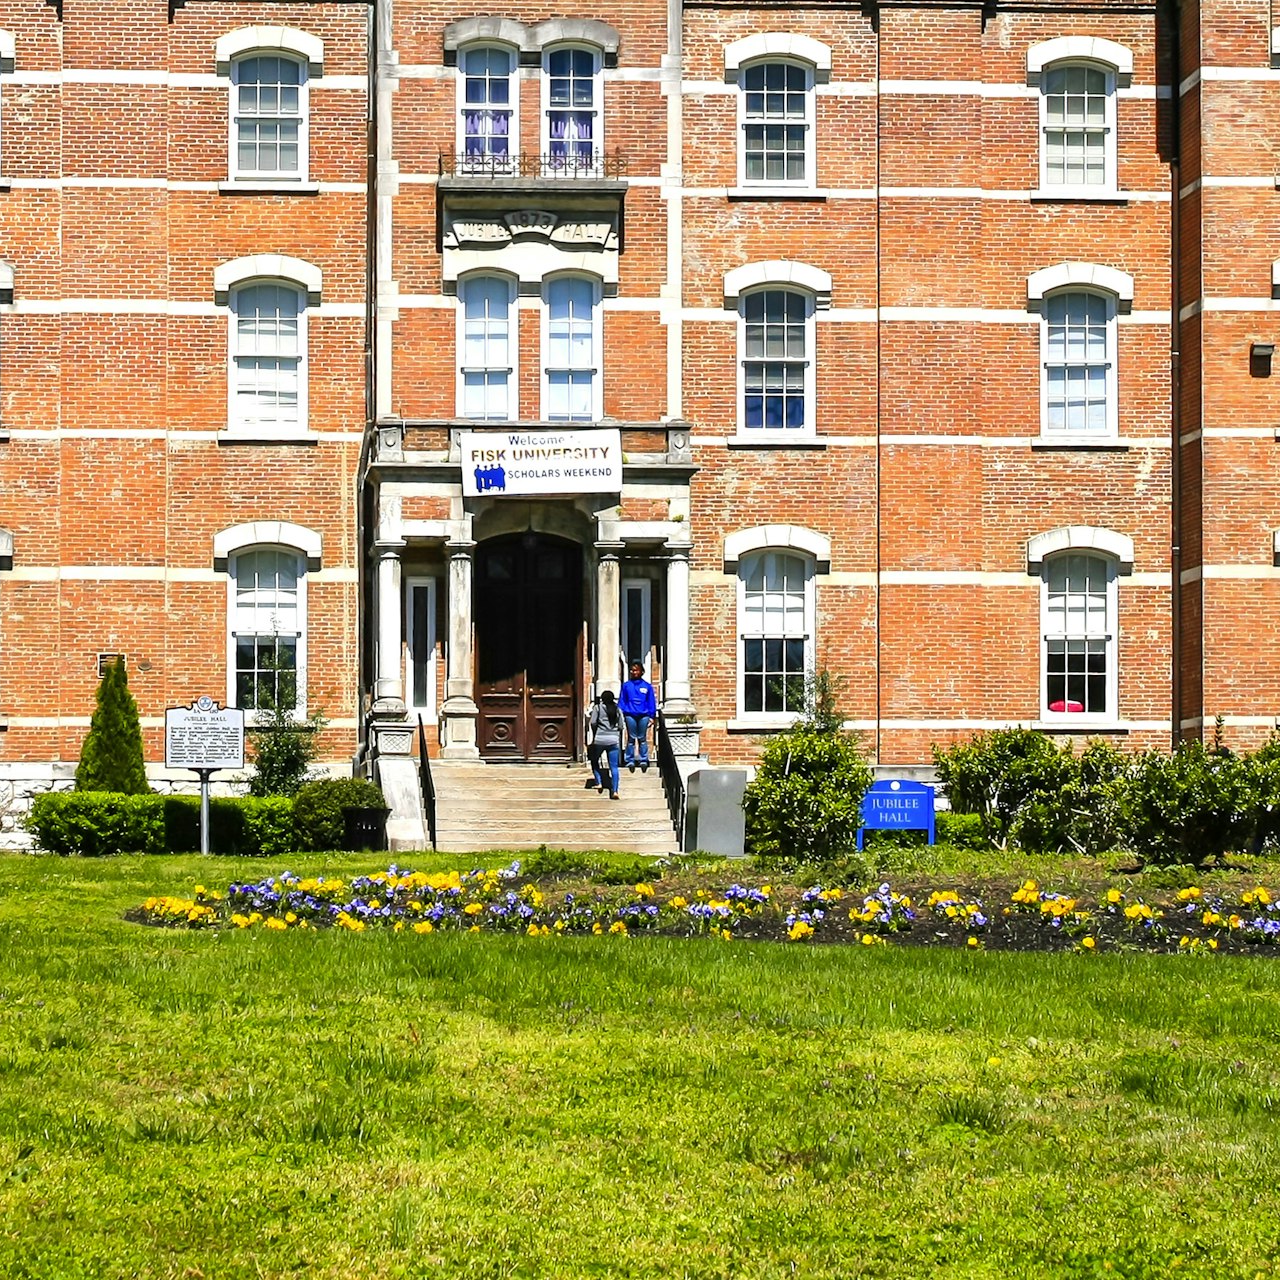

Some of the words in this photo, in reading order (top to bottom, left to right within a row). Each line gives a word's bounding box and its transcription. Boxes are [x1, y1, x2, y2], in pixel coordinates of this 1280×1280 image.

[511, 213, 551, 229] 1873
[562, 222, 604, 239] HALL
[508, 435, 565, 446] Welcome
[471, 449, 507, 462] FISK
[512, 446, 610, 461] UNIVERSITY
[508, 469, 560, 479] SCHOLARS
[564, 467, 612, 477] WEEKEND
[872, 798, 919, 810] JUBILEE
[879, 812, 911, 823] HALL
